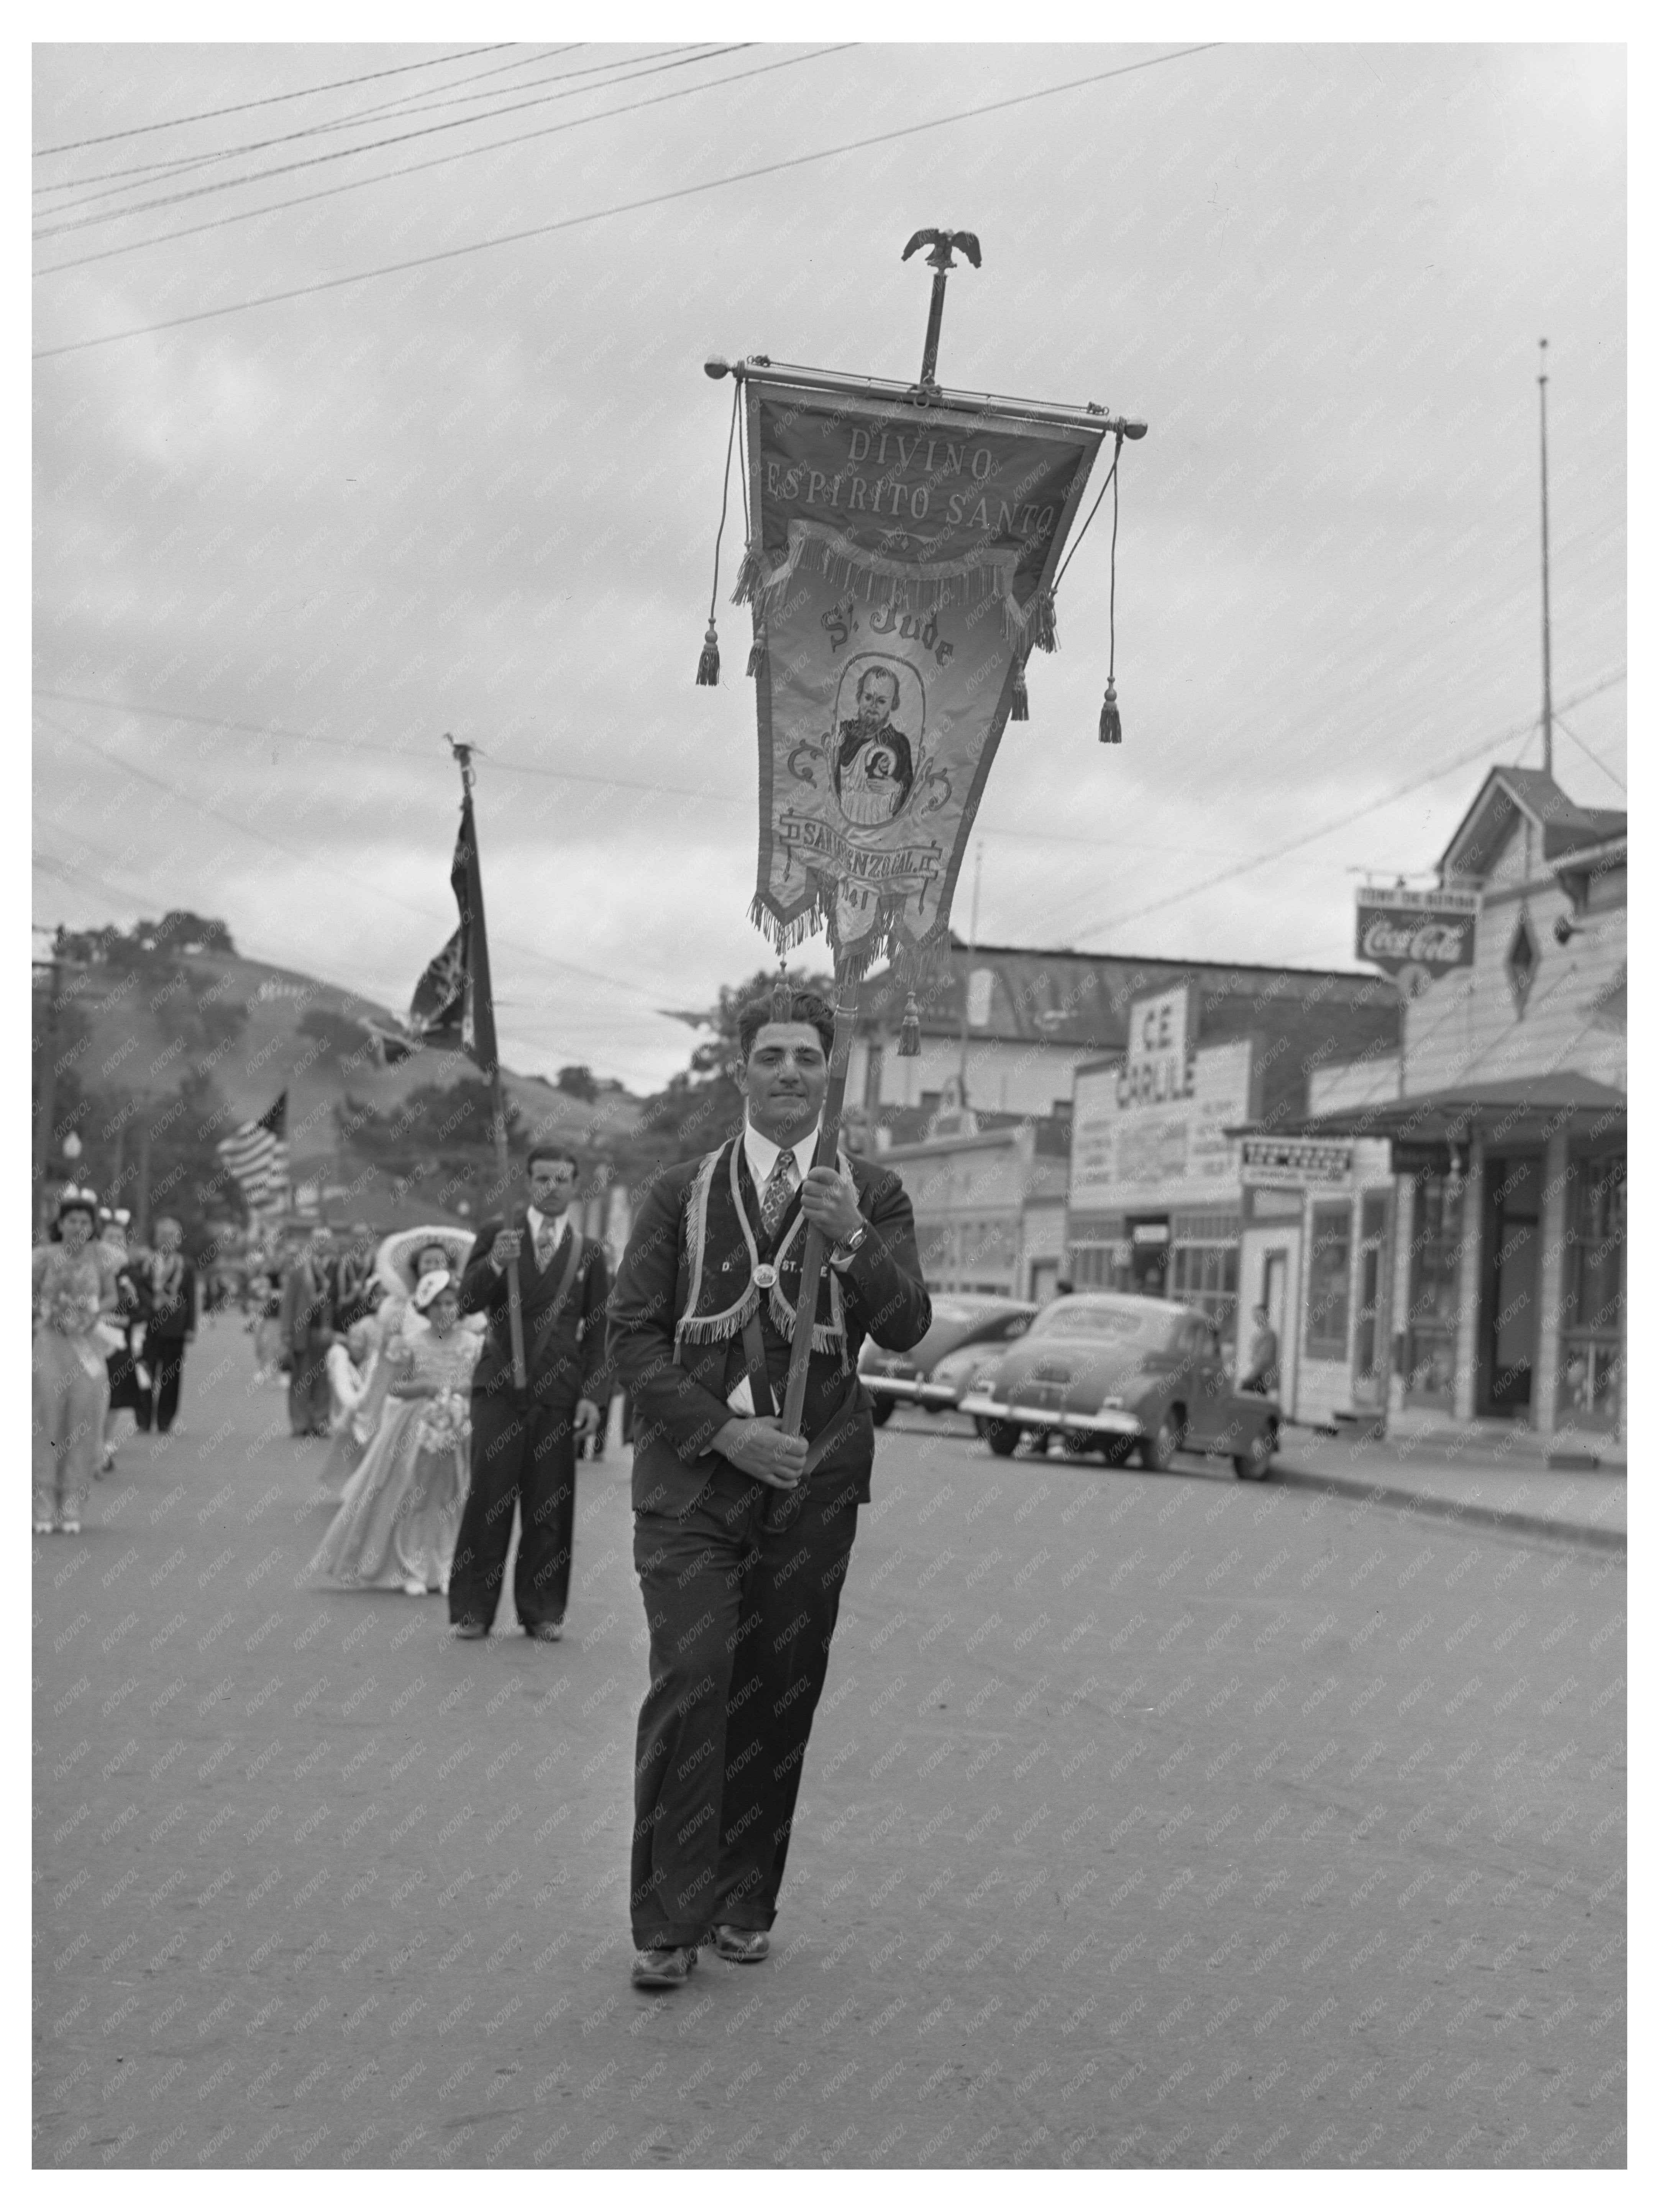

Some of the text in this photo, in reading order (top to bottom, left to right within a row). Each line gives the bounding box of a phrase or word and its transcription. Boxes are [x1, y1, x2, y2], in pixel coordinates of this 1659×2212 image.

[848, 428, 992, 480] DIVINO
[767, 462, 1054, 533] ESPIRITO SANTO
[870, 600, 954, 666] Jude
[837, 839, 890, 878] ENZO
